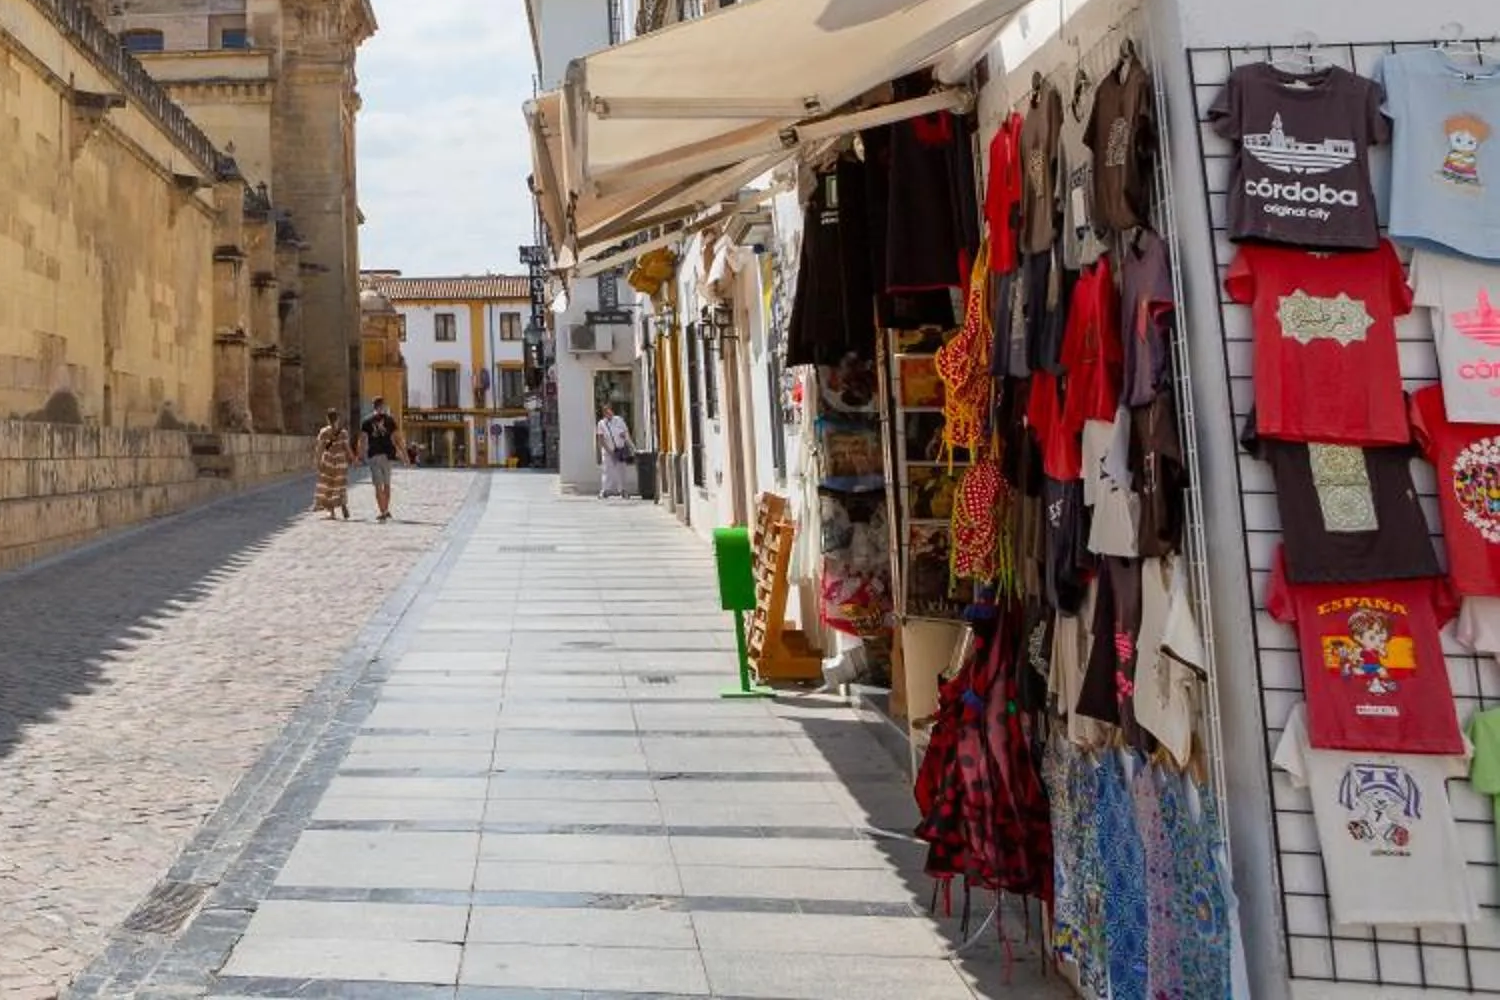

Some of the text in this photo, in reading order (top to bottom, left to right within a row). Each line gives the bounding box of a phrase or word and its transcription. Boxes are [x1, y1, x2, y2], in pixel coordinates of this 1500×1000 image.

[1245, 177, 1358, 206] córdoba
[1263, 203, 1331, 221] original city
